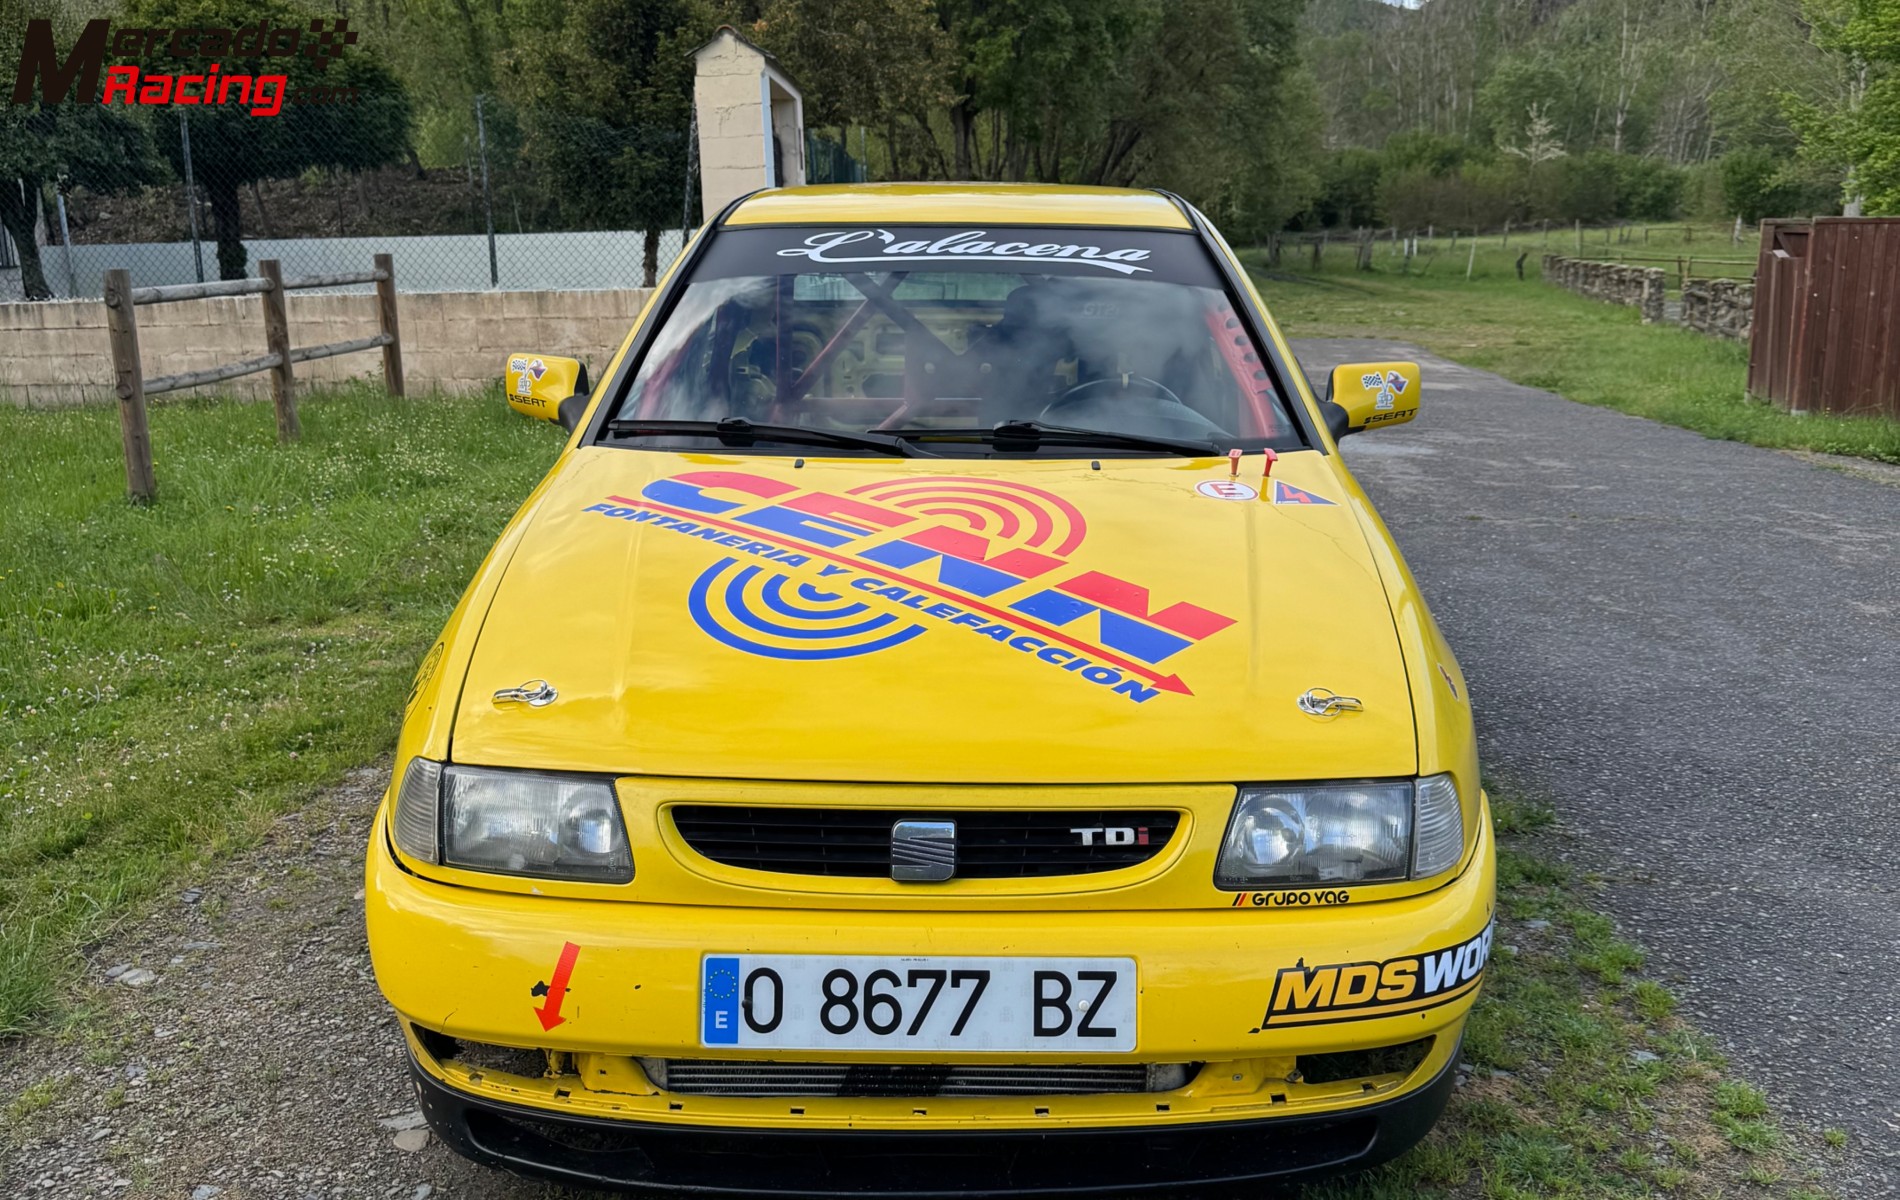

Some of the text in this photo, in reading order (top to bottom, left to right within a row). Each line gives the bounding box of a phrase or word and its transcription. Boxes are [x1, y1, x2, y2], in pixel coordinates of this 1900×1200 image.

[514, 395, 547, 408] SEAT
[1371, 407, 1418, 423] SEAT
[641, 471, 1239, 665] CENN
[582, 503, 1161, 703] FONTANERIA Y CALEFACCIÓN
[715, 1010, 729, 1029] E
[819, 968, 991, 1036] 8677
[1033, 970, 1118, 1037] BZ
